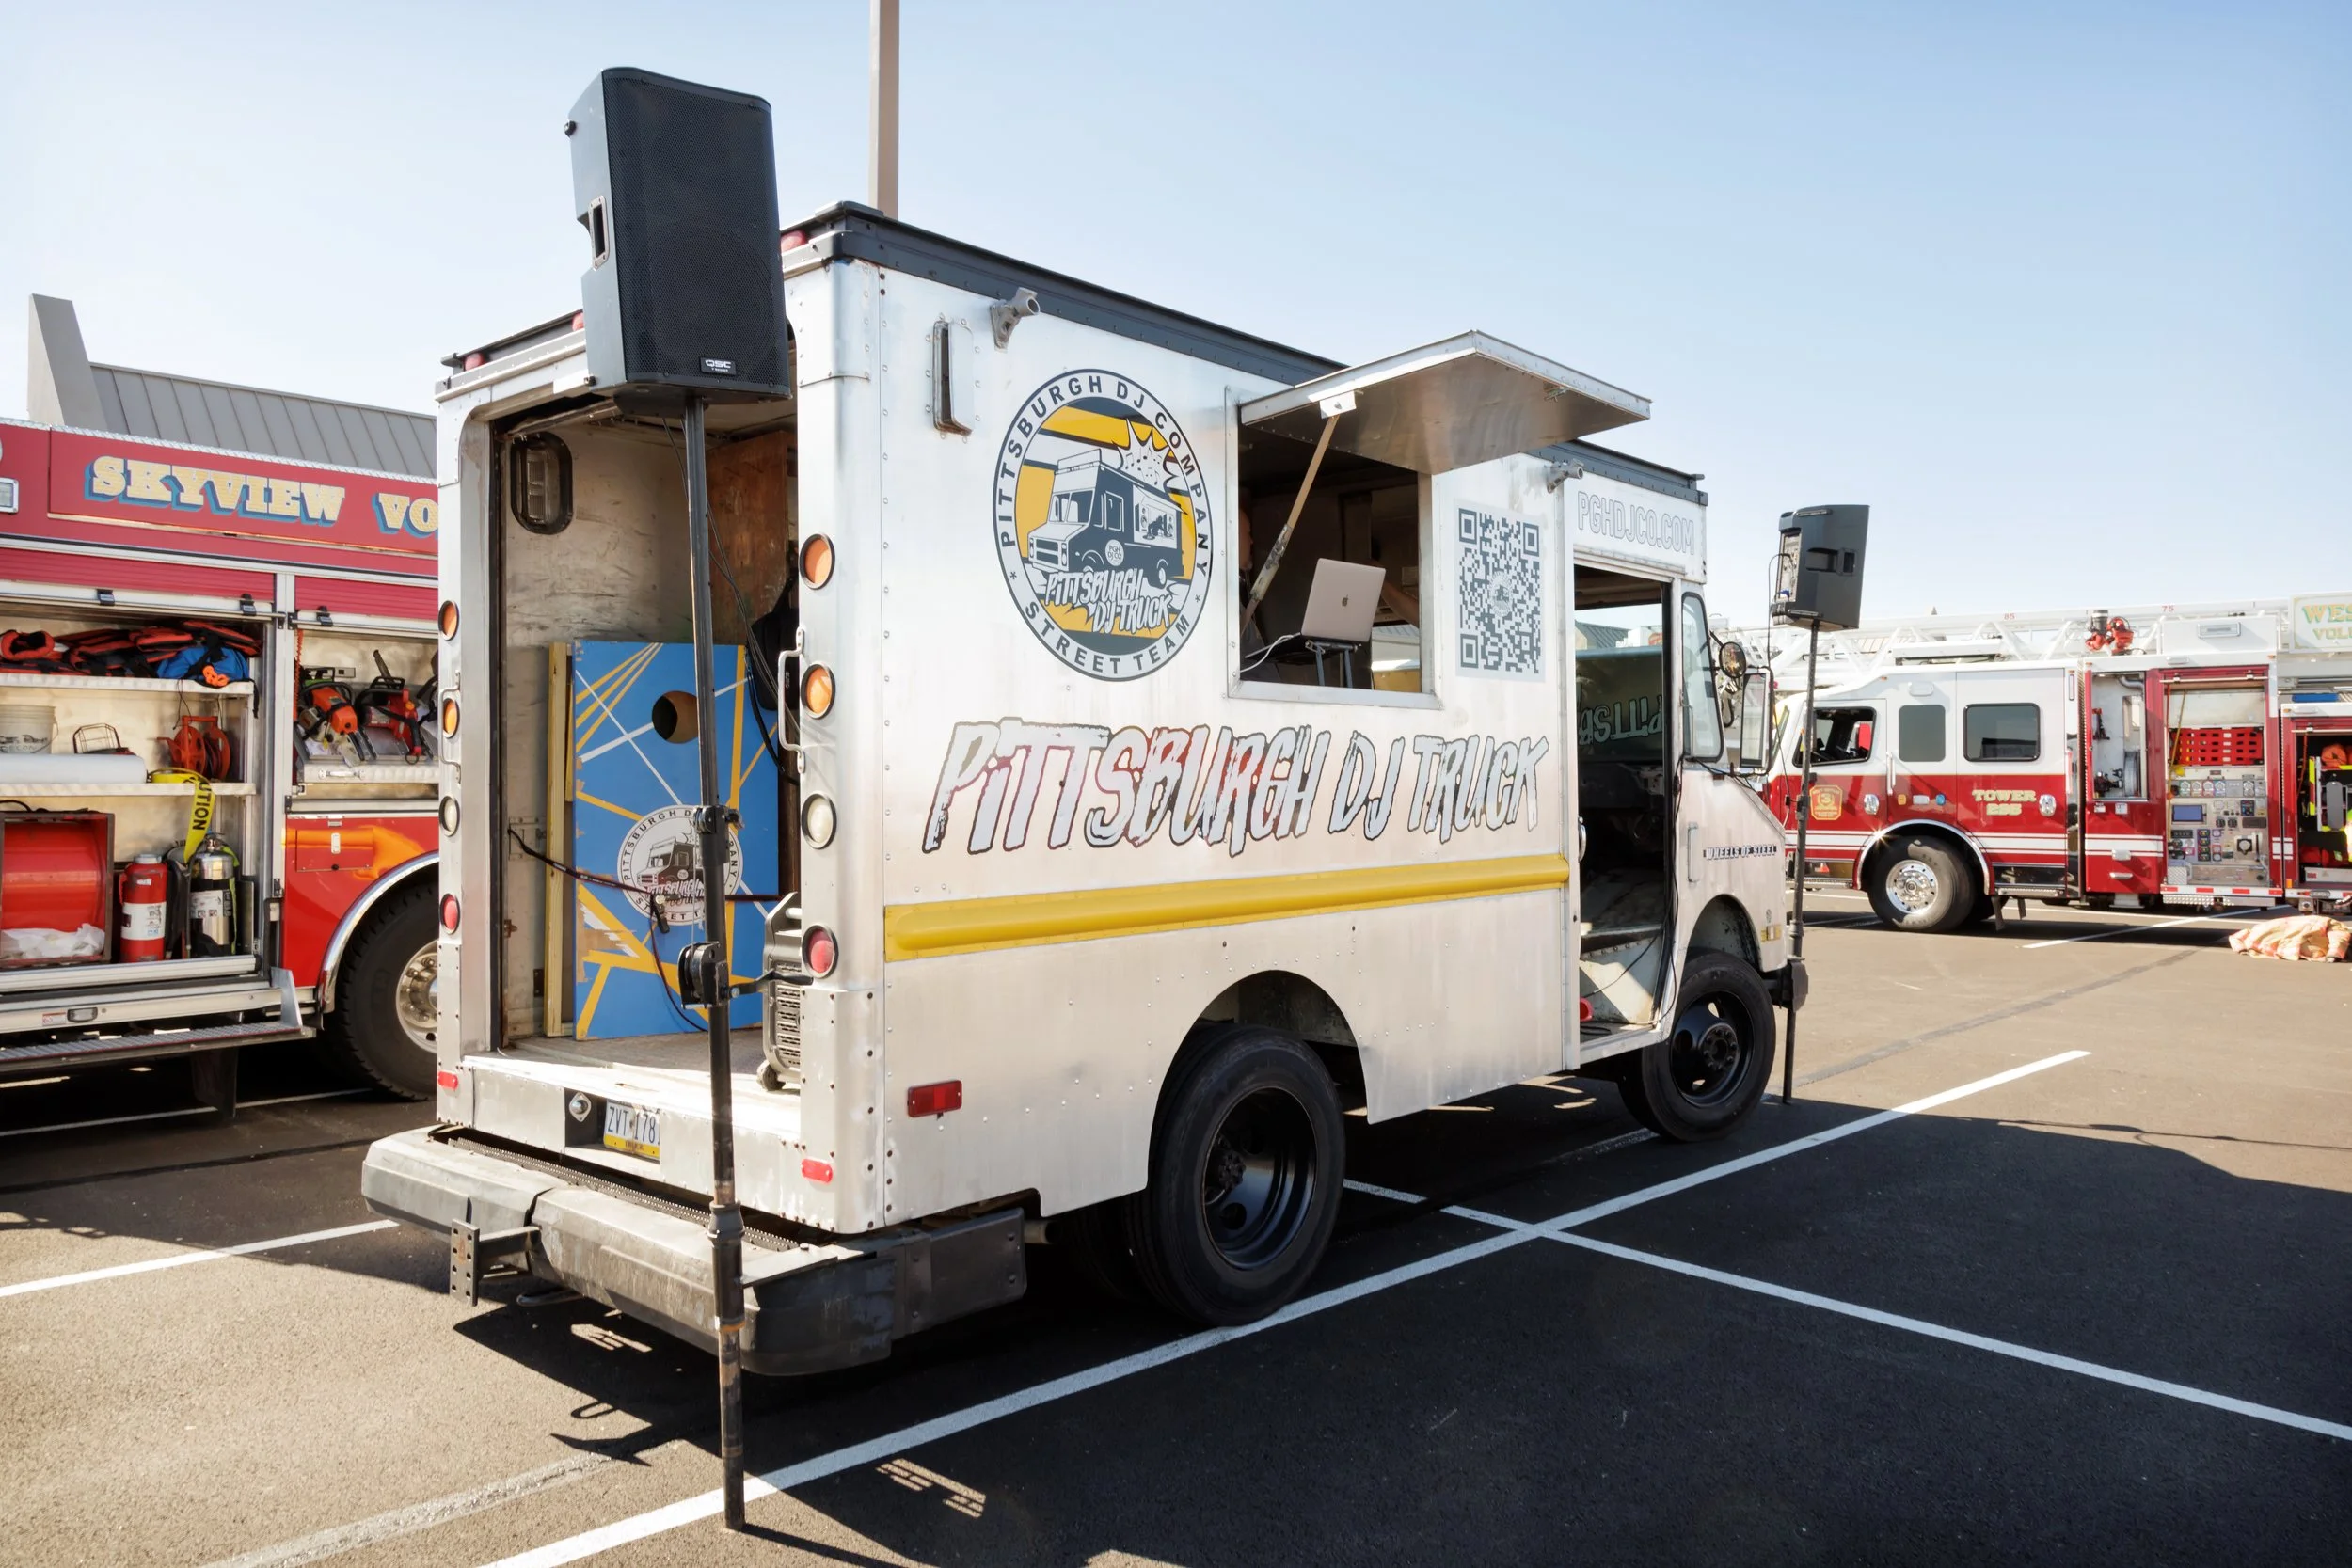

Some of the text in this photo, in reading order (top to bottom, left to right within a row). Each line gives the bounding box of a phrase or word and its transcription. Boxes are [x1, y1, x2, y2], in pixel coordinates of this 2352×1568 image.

[705, 359, 731, 369] QSC
[84, 455, 345, 527] SKYVIEW
[998, 375, 1208, 577] PITTSBURGH DJ COMPANY
[1578, 491, 1693, 555] PGHDJCO.COM
[1025, 601, 1190, 674] STREET TEAM
[1092, 594, 1174, 634] DJ TRUCK
[192, 783, 212, 830] UTION
[1327, 730, 1406, 840] DJ
[1408, 734, 1549, 844] TRUCK
[1972, 789, 2037, 802] TOWER
[622, 810, 676, 880] PITTSBURGH
[636, 897, 687, 920] STET
